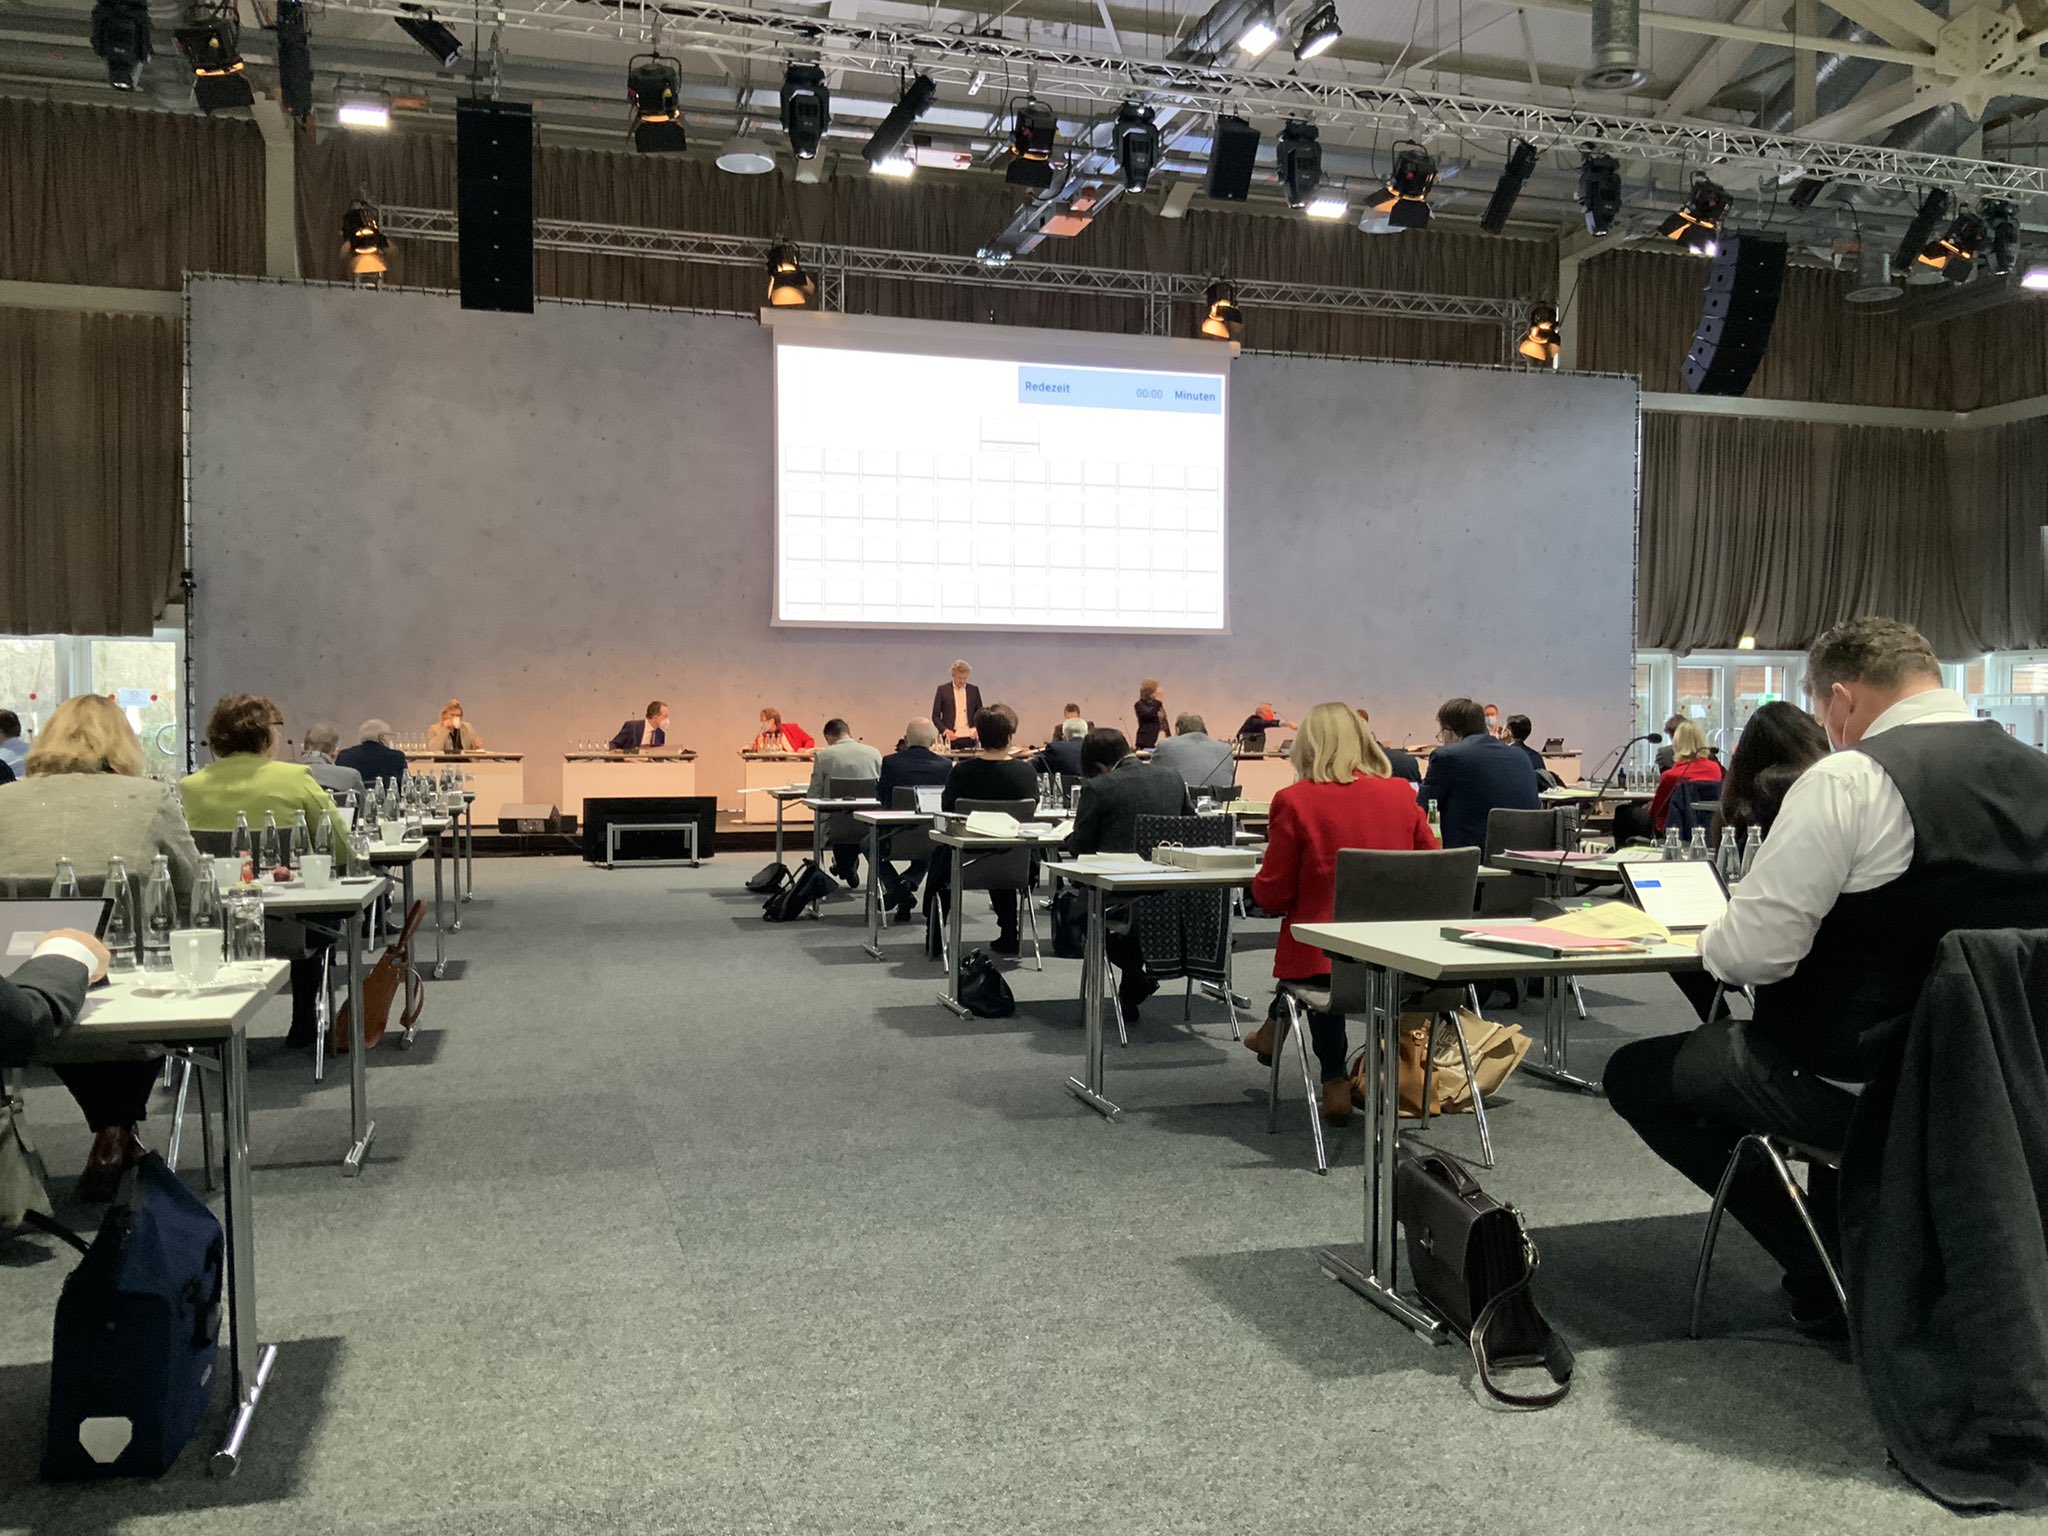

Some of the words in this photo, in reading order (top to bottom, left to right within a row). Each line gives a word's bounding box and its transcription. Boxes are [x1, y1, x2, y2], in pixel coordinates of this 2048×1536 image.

[1025, 381, 1070, 393] Redezeit
[1136, 388, 1163, 399] 00:00
[1175, 390, 1216, 401] Minuten
